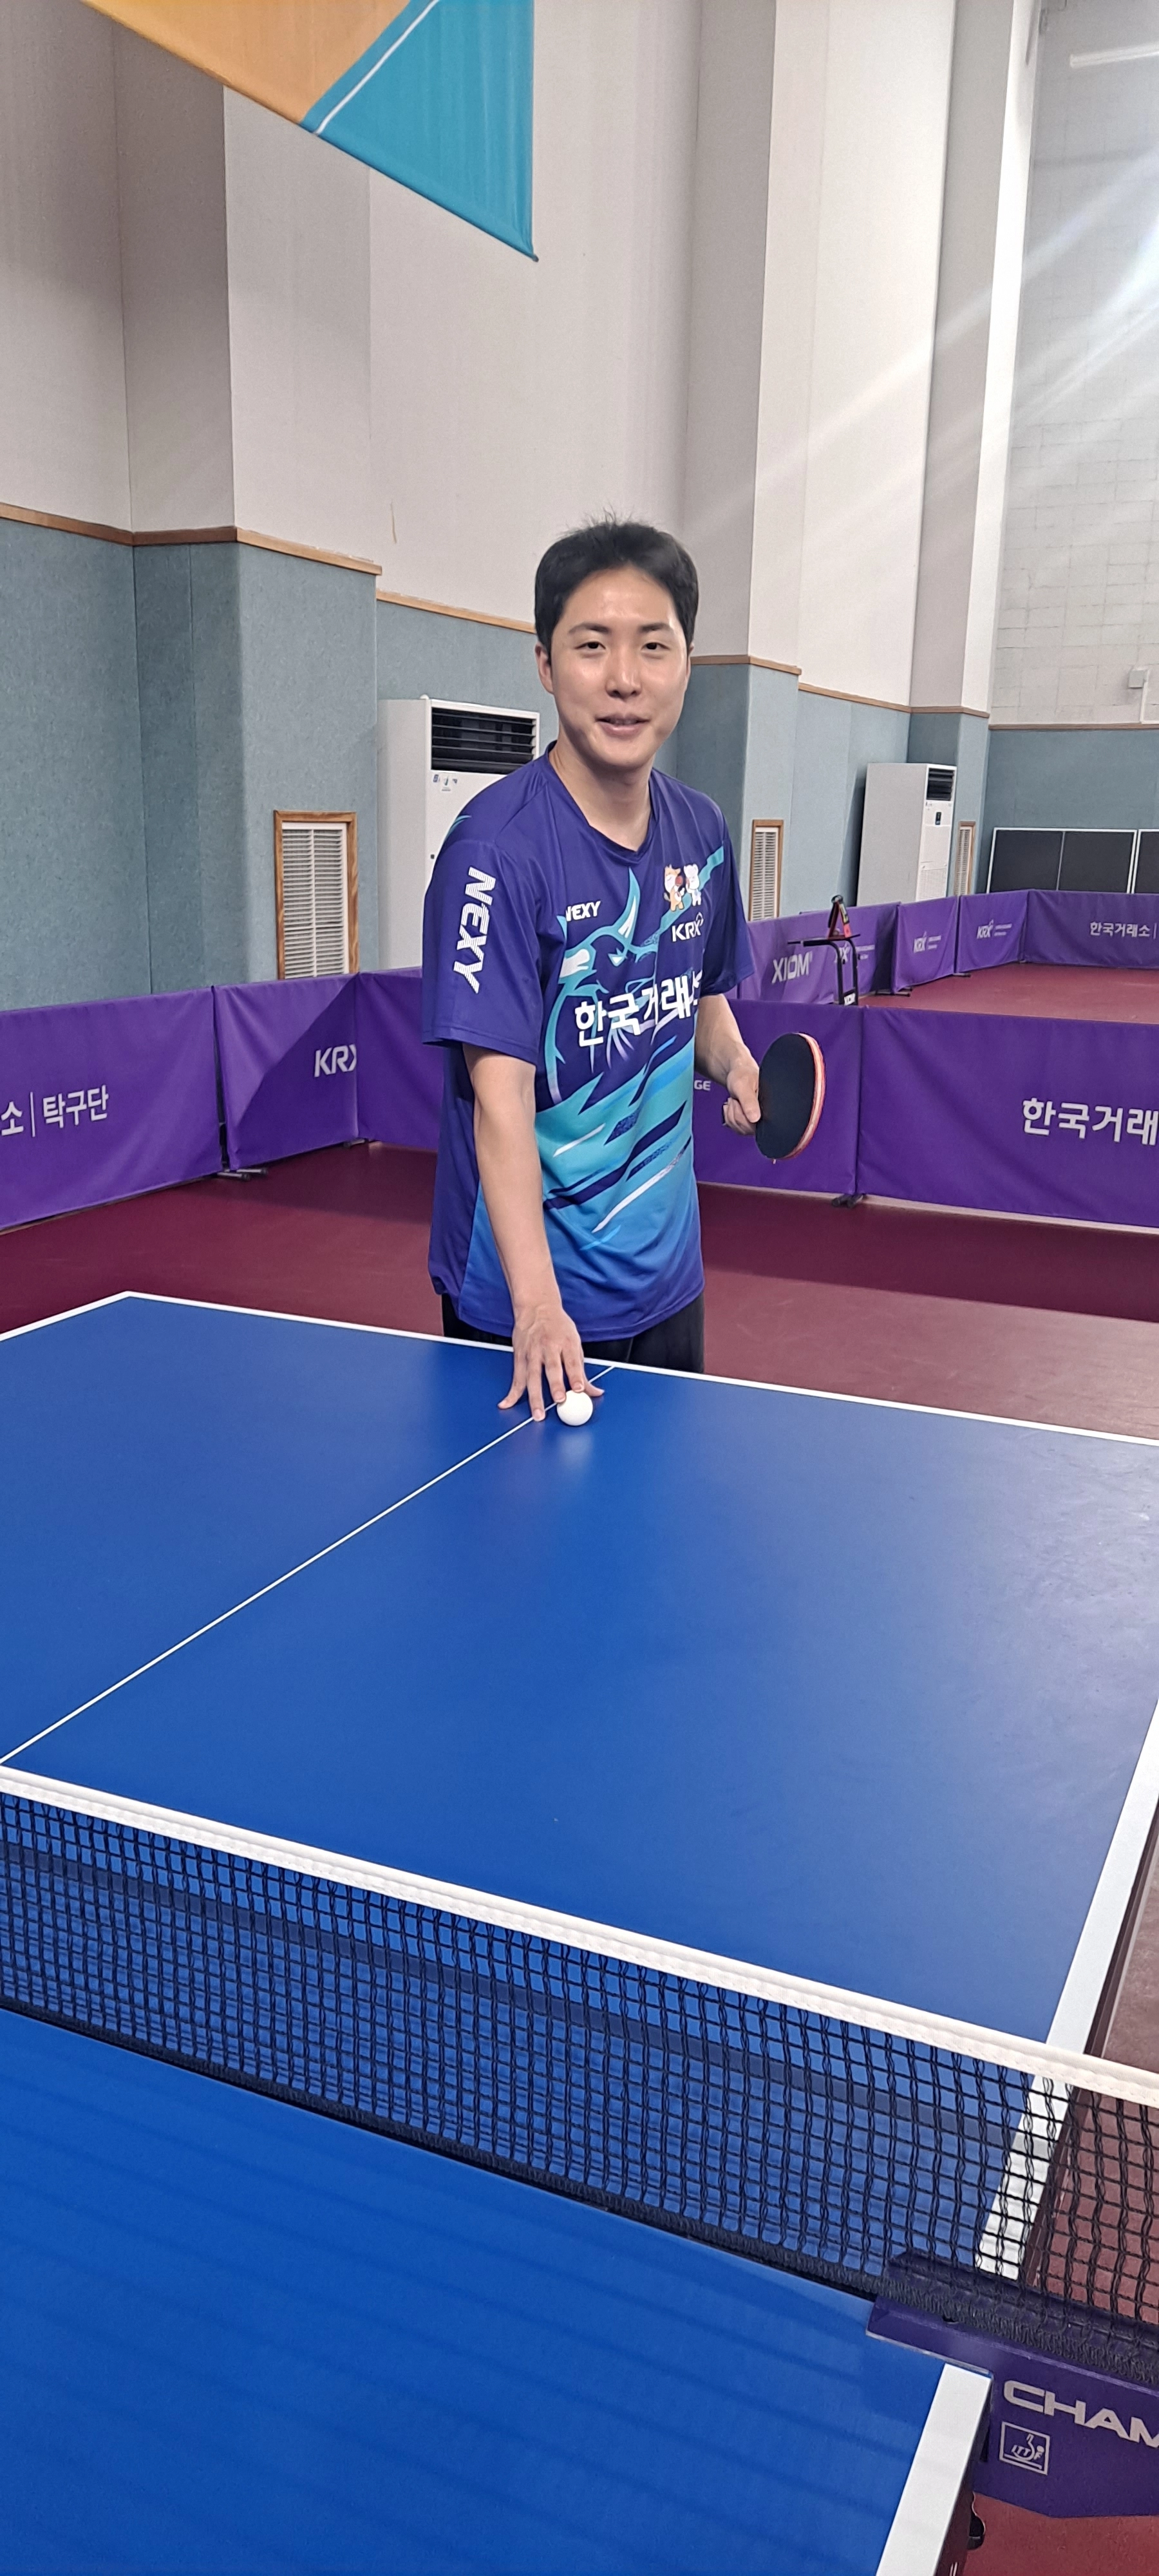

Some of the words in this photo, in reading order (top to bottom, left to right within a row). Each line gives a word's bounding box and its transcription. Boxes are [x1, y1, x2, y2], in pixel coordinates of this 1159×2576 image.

[453, 866, 496, 994] NEXY
[672, 918, 703, 942] KRX
[1089, 922, 1151, 937] 한국거래소
[771, 952, 811, 983] XIOM
[42, 1084, 109, 1128] 탁구단
[1022, 1097, 1159, 1146] 한국거래
